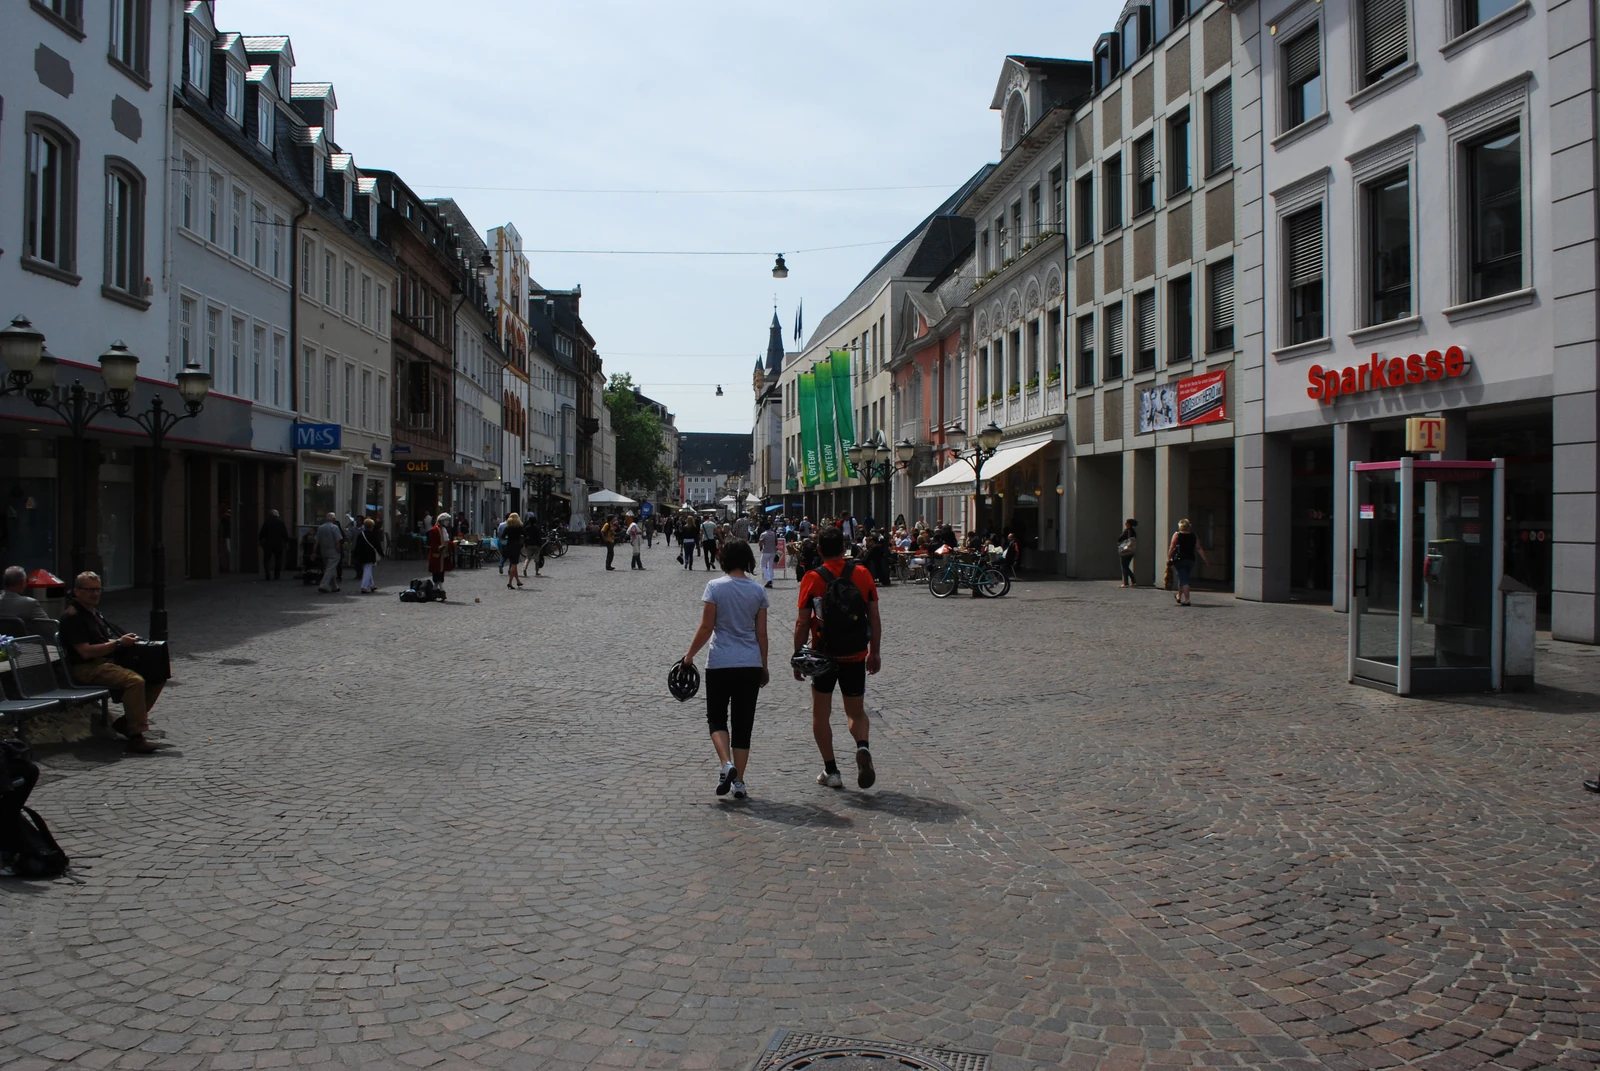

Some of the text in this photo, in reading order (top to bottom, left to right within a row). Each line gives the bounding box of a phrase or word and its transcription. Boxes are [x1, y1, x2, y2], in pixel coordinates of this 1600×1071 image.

[1307, 346, 1465, 405] Sparkasse
[297, 427, 334, 445] M&S
[1419, 420, 1441, 449] T
[407, 461, 429, 471] O&H
